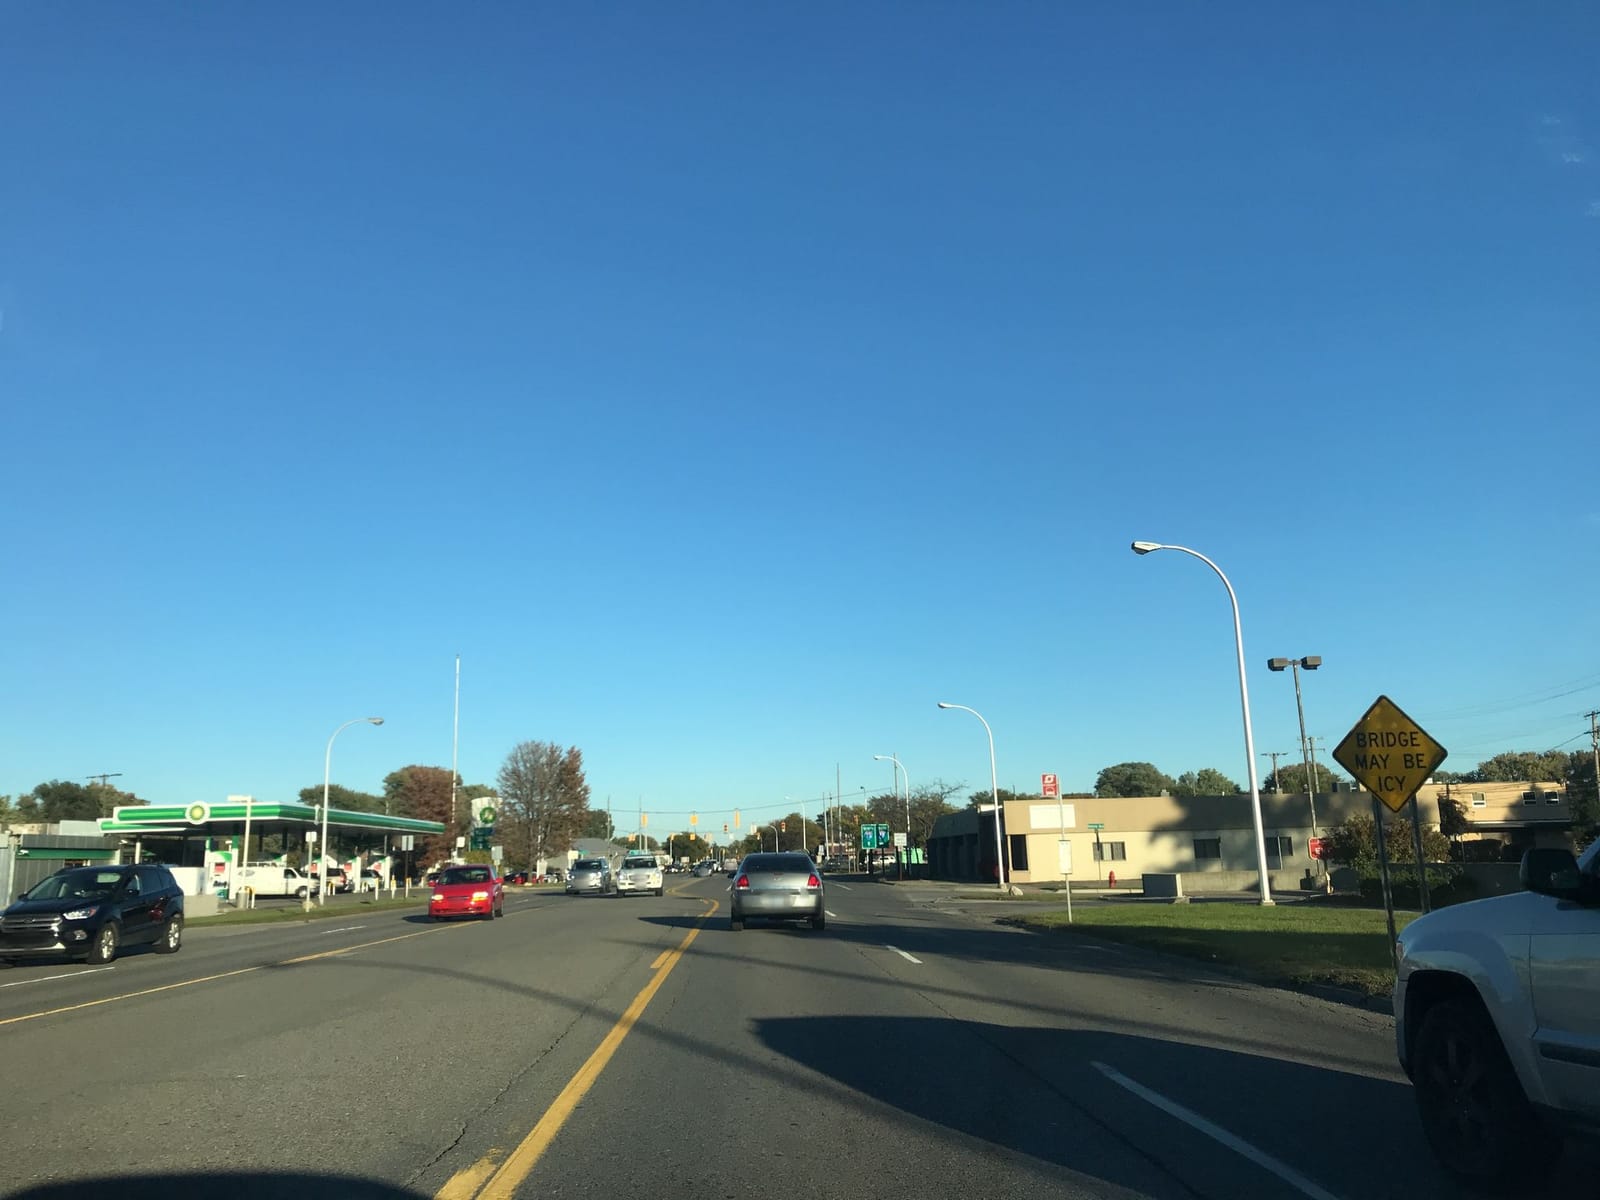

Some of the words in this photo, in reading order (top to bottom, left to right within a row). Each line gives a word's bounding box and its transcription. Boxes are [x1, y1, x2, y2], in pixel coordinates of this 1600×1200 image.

[1356, 731, 1421, 748] BRIDGE
[1355, 754, 1389, 770] MAY
[1403, 753, 1427, 769] BE
[1378, 776, 1406, 792] ICY
